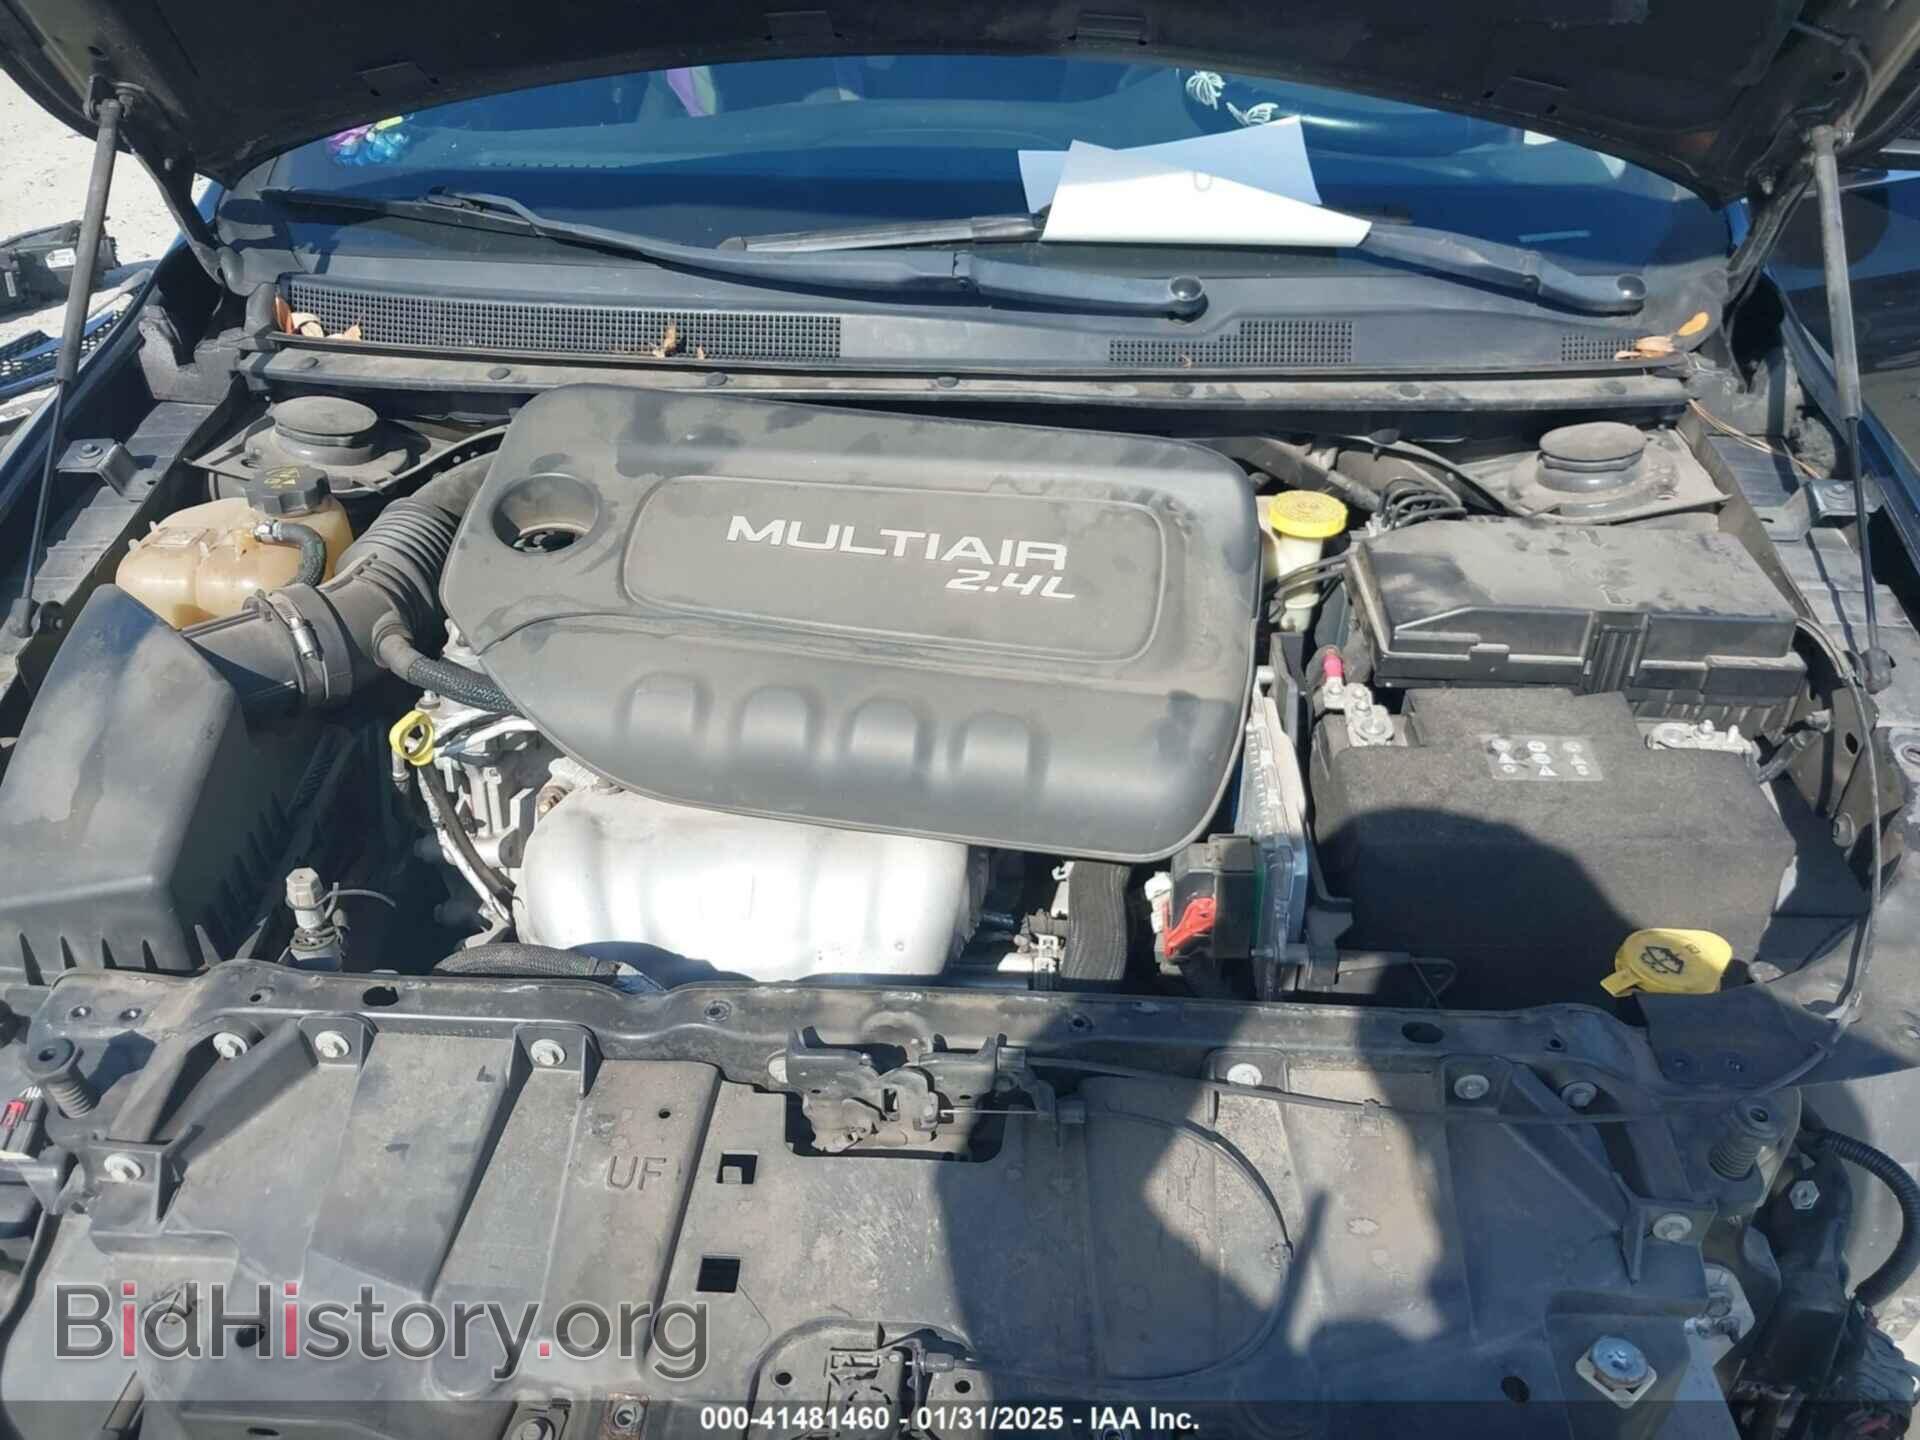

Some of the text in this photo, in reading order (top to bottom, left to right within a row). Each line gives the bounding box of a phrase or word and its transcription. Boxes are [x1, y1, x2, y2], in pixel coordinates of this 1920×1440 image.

[727, 515, 1067, 570] MULTIAIR
[945, 568, 1076, 599] 2.4L
[606, 1155, 667, 1191] UF
